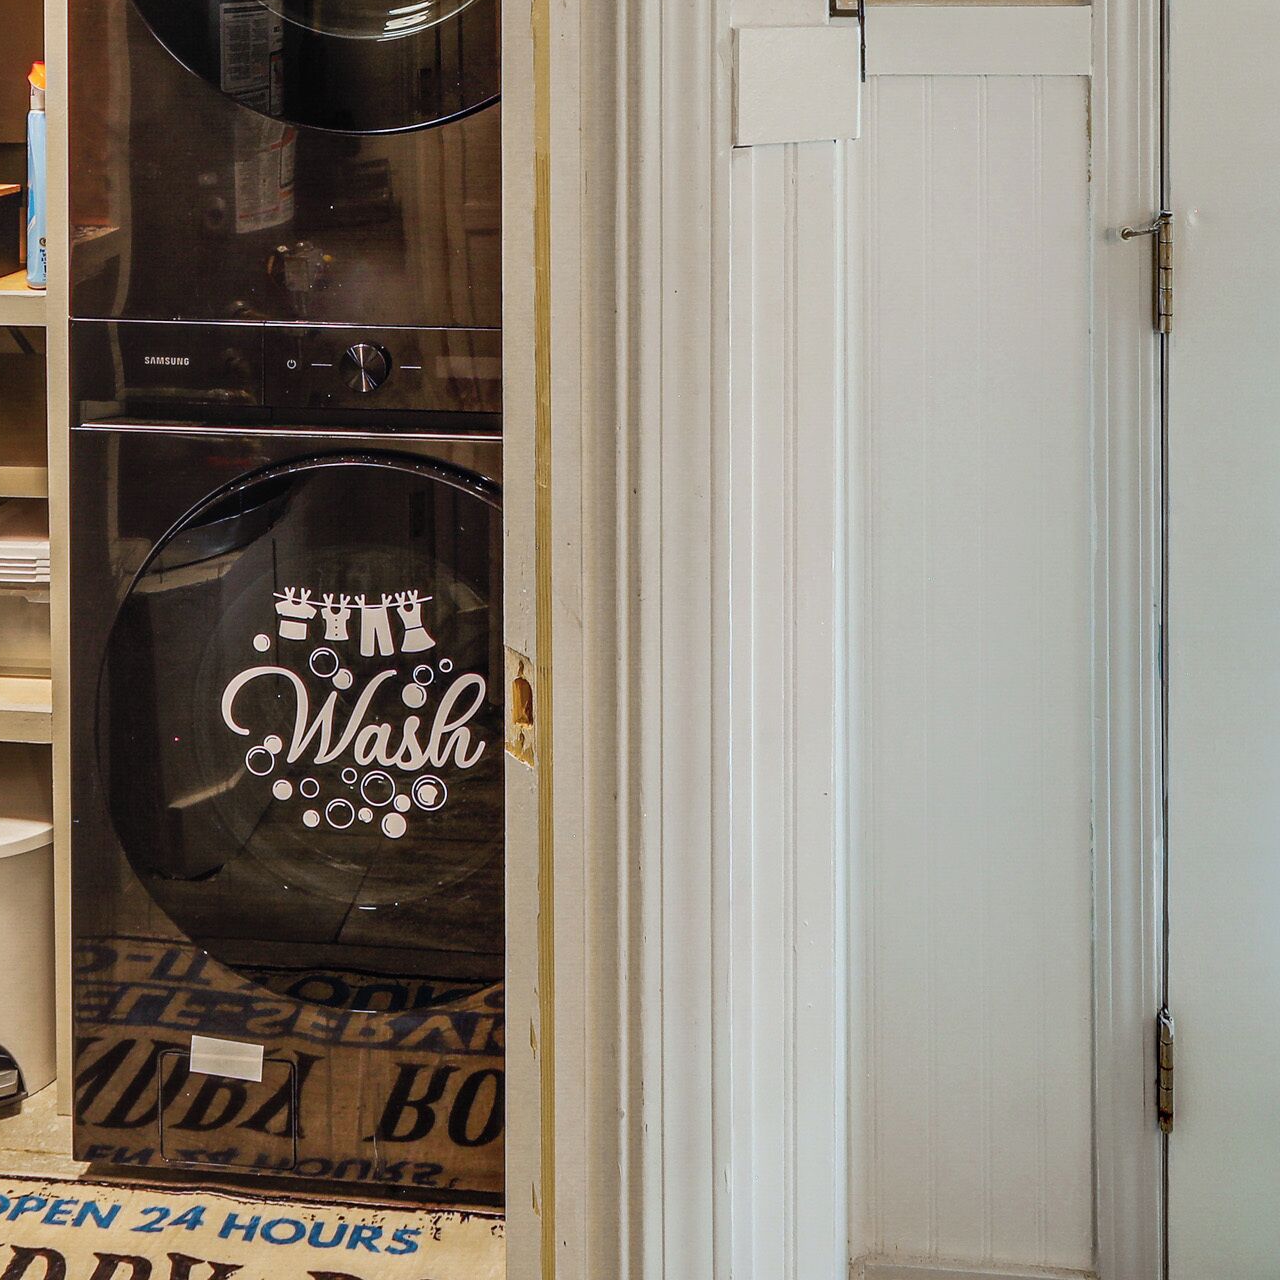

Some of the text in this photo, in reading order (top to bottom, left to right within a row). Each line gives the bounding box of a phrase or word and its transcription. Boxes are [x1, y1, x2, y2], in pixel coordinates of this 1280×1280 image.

[144, 356, 190, 366] SAMSUNG
[221, 666, 486, 771] Wash
[130, 1204, 208, 1233] 24
[219, 1212, 423, 1256] HOURS
